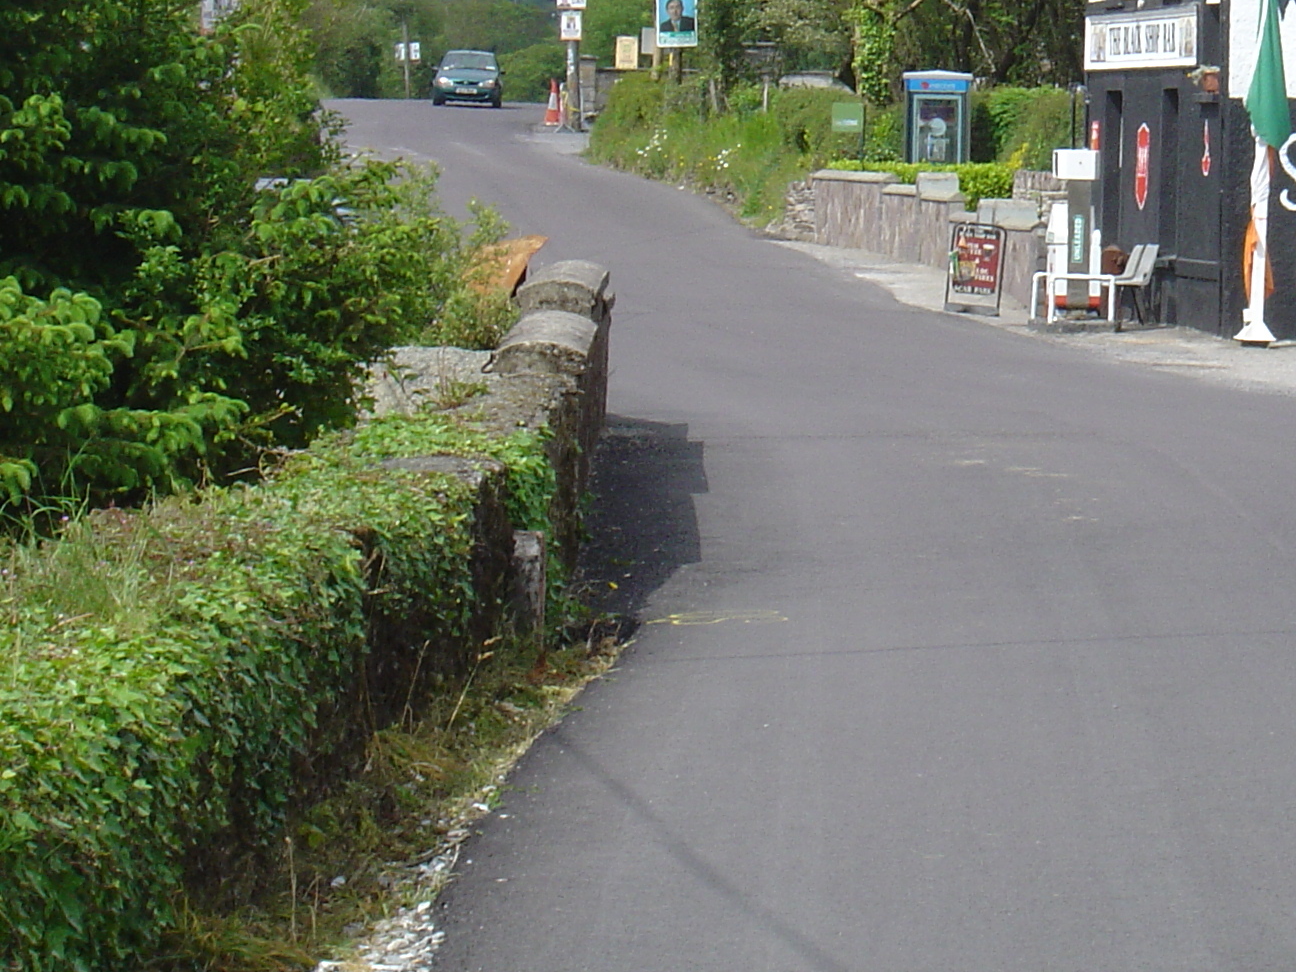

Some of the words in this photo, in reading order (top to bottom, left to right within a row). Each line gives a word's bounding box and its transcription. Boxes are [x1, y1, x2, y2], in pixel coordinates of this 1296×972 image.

[1109, 27, 1121, 56] THE
[1123, 25, 1142, 55] BLACK
[1145, 24, 1160, 54] SHOP
[1163, 22, 1175, 53] BAR
[1074, 218, 1082, 260] UNLEADED
